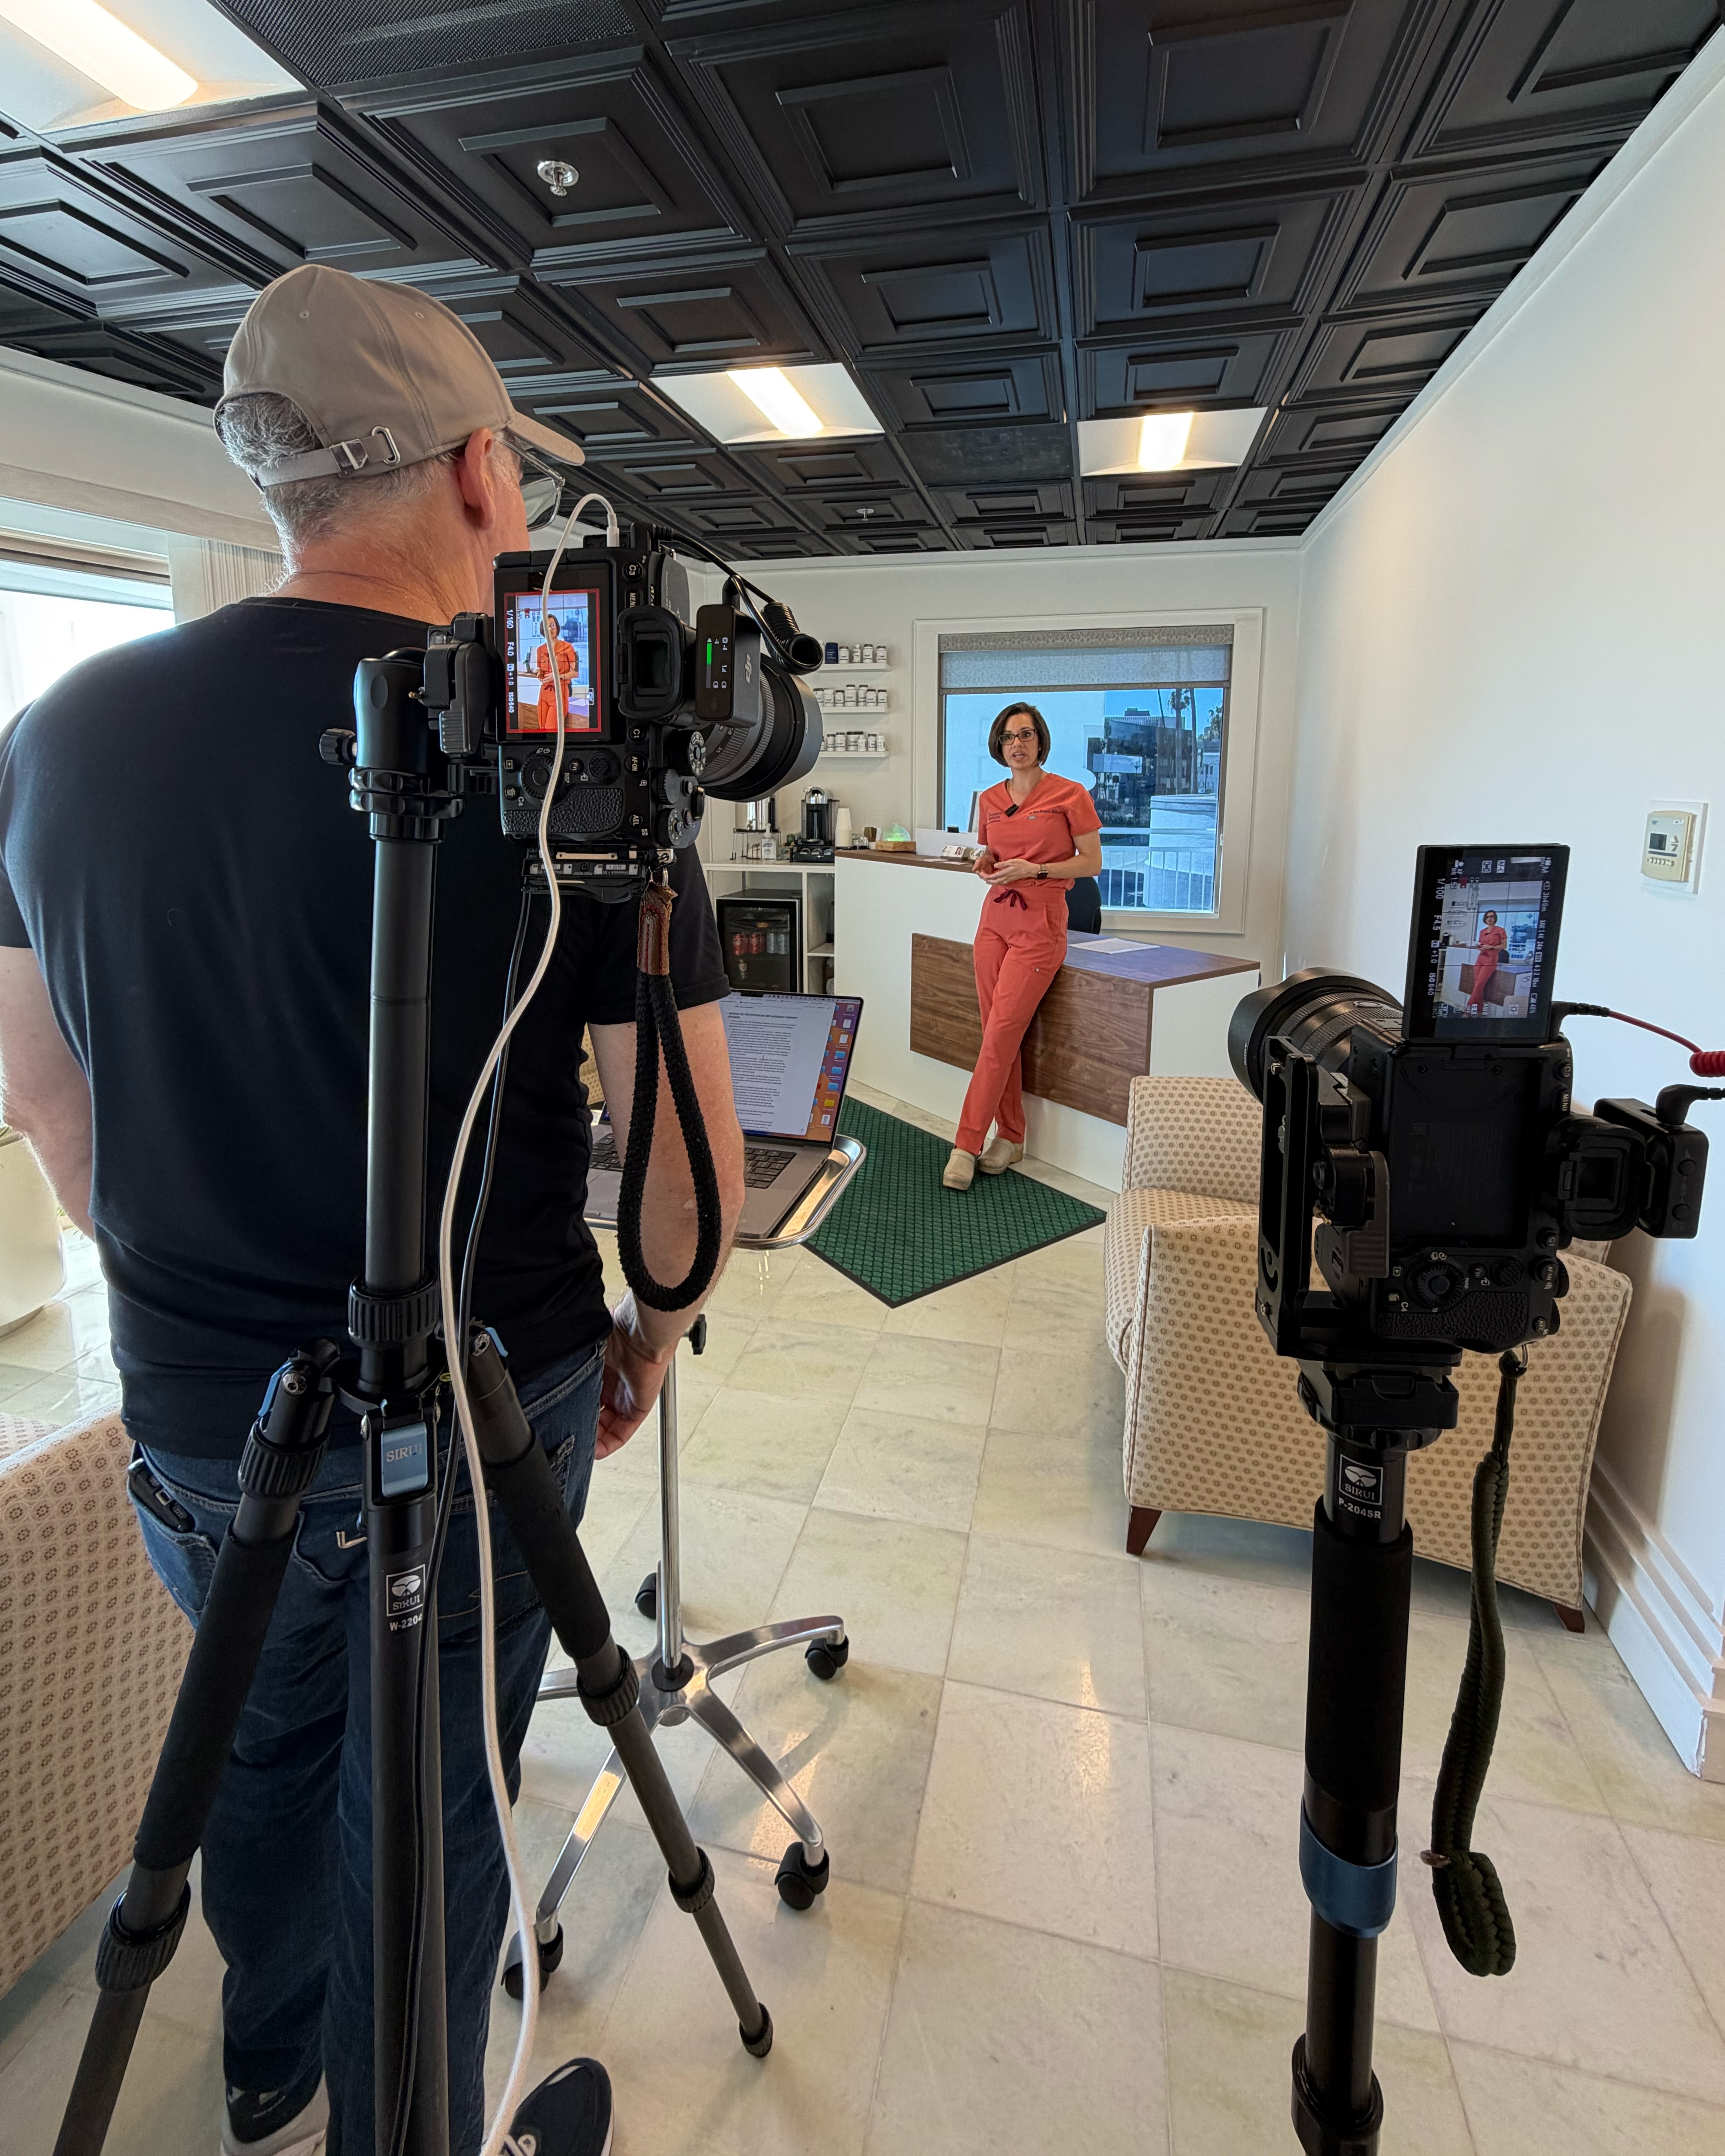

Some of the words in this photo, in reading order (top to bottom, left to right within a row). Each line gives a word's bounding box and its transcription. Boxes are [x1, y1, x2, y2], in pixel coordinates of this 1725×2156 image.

[629, 564, 636, 575] C3
[633, 729, 640, 738] C1
[572, 763, 578, 771] Fn
[518, 797, 524, 806] C4
[1436, 878, 1446, 899] 1/100
[1401, 1301, 1409, 1312] C4
[386, 1443, 423, 1462] SIRUI
[1344, 1483, 1375, 1500] SIRUI
[1338, 1497, 1381, 1519] P-204SR
[393, 1594, 420, 1610] SIRUI
